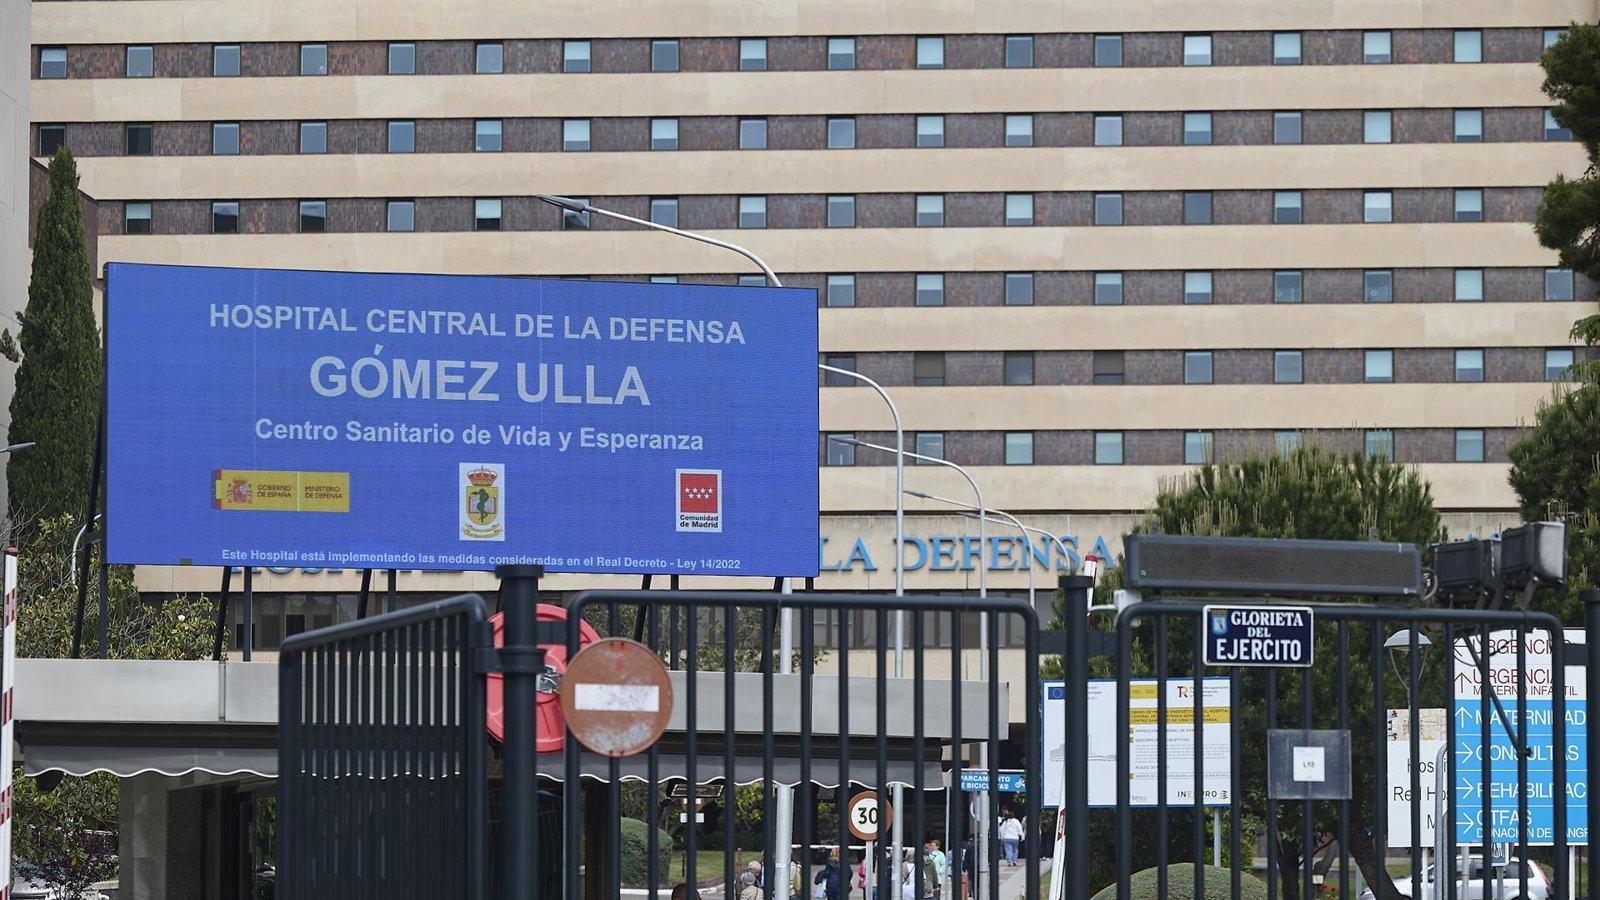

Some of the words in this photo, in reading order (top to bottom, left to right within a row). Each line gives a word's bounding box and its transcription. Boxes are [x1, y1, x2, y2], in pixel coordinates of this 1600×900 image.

[210, 303, 358, 332] HOSPITAL
[366, 308, 506, 337] CENTRAL
[515, 313, 554, 338] DE
[564, 316, 602, 340] LA
[609, 317, 746, 345] DEFENSA
[309, 343, 500, 401] GÓMEZ
[516, 362, 651, 406] ULLA
[255, 418, 338, 441] Centro
[346, 420, 455, 444] Sanitario
[462, 424, 491, 445] de
[498, 425, 551, 447] Vida
[558, 430, 573, 452] y
[580, 427, 704, 453] Esperanza
[257, 484, 292, 492] GOBIERNO
[268, 490, 292, 499] ESPAÑA
[304, 485, 341, 493] MINISTERIO
[315, 492, 343, 500] DEFENSA
[222, 550, 247, 560] Este
[250, 550, 298, 562] Hospital
[301, 551, 325, 561] está
[328, 551, 416, 564] implementando
[419, 553, 435, 563] las
[439, 554, 486, 564] medidas
[489, 555, 563, 566] consideradas
[567, 558, 580, 566] en
[583, 557, 593, 566] el
[597, 557, 621, 567] Real
[624, 557, 667, 568] Decreto
[677, 558, 697, 570] Ley
[700, 558, 741, 569] 14/2022
[819, 536, 877, 571] LA
[893, 534, 1115, 571] DEFENSA
[1230, 611, 1304, 626] GLORIETA
[1247, 627, 1271, 638] DEL
[1216, 638, 1302, 661] EJERCITO
[1472, 669, 1554, 684] URGENCI
[1531, 686, 1578, 696] INFATIL
[1475, 710, 1586, 725] MATERNIAD
[858, 807, 878, 824] 30
[1537, 827, 1552, 838] DE
